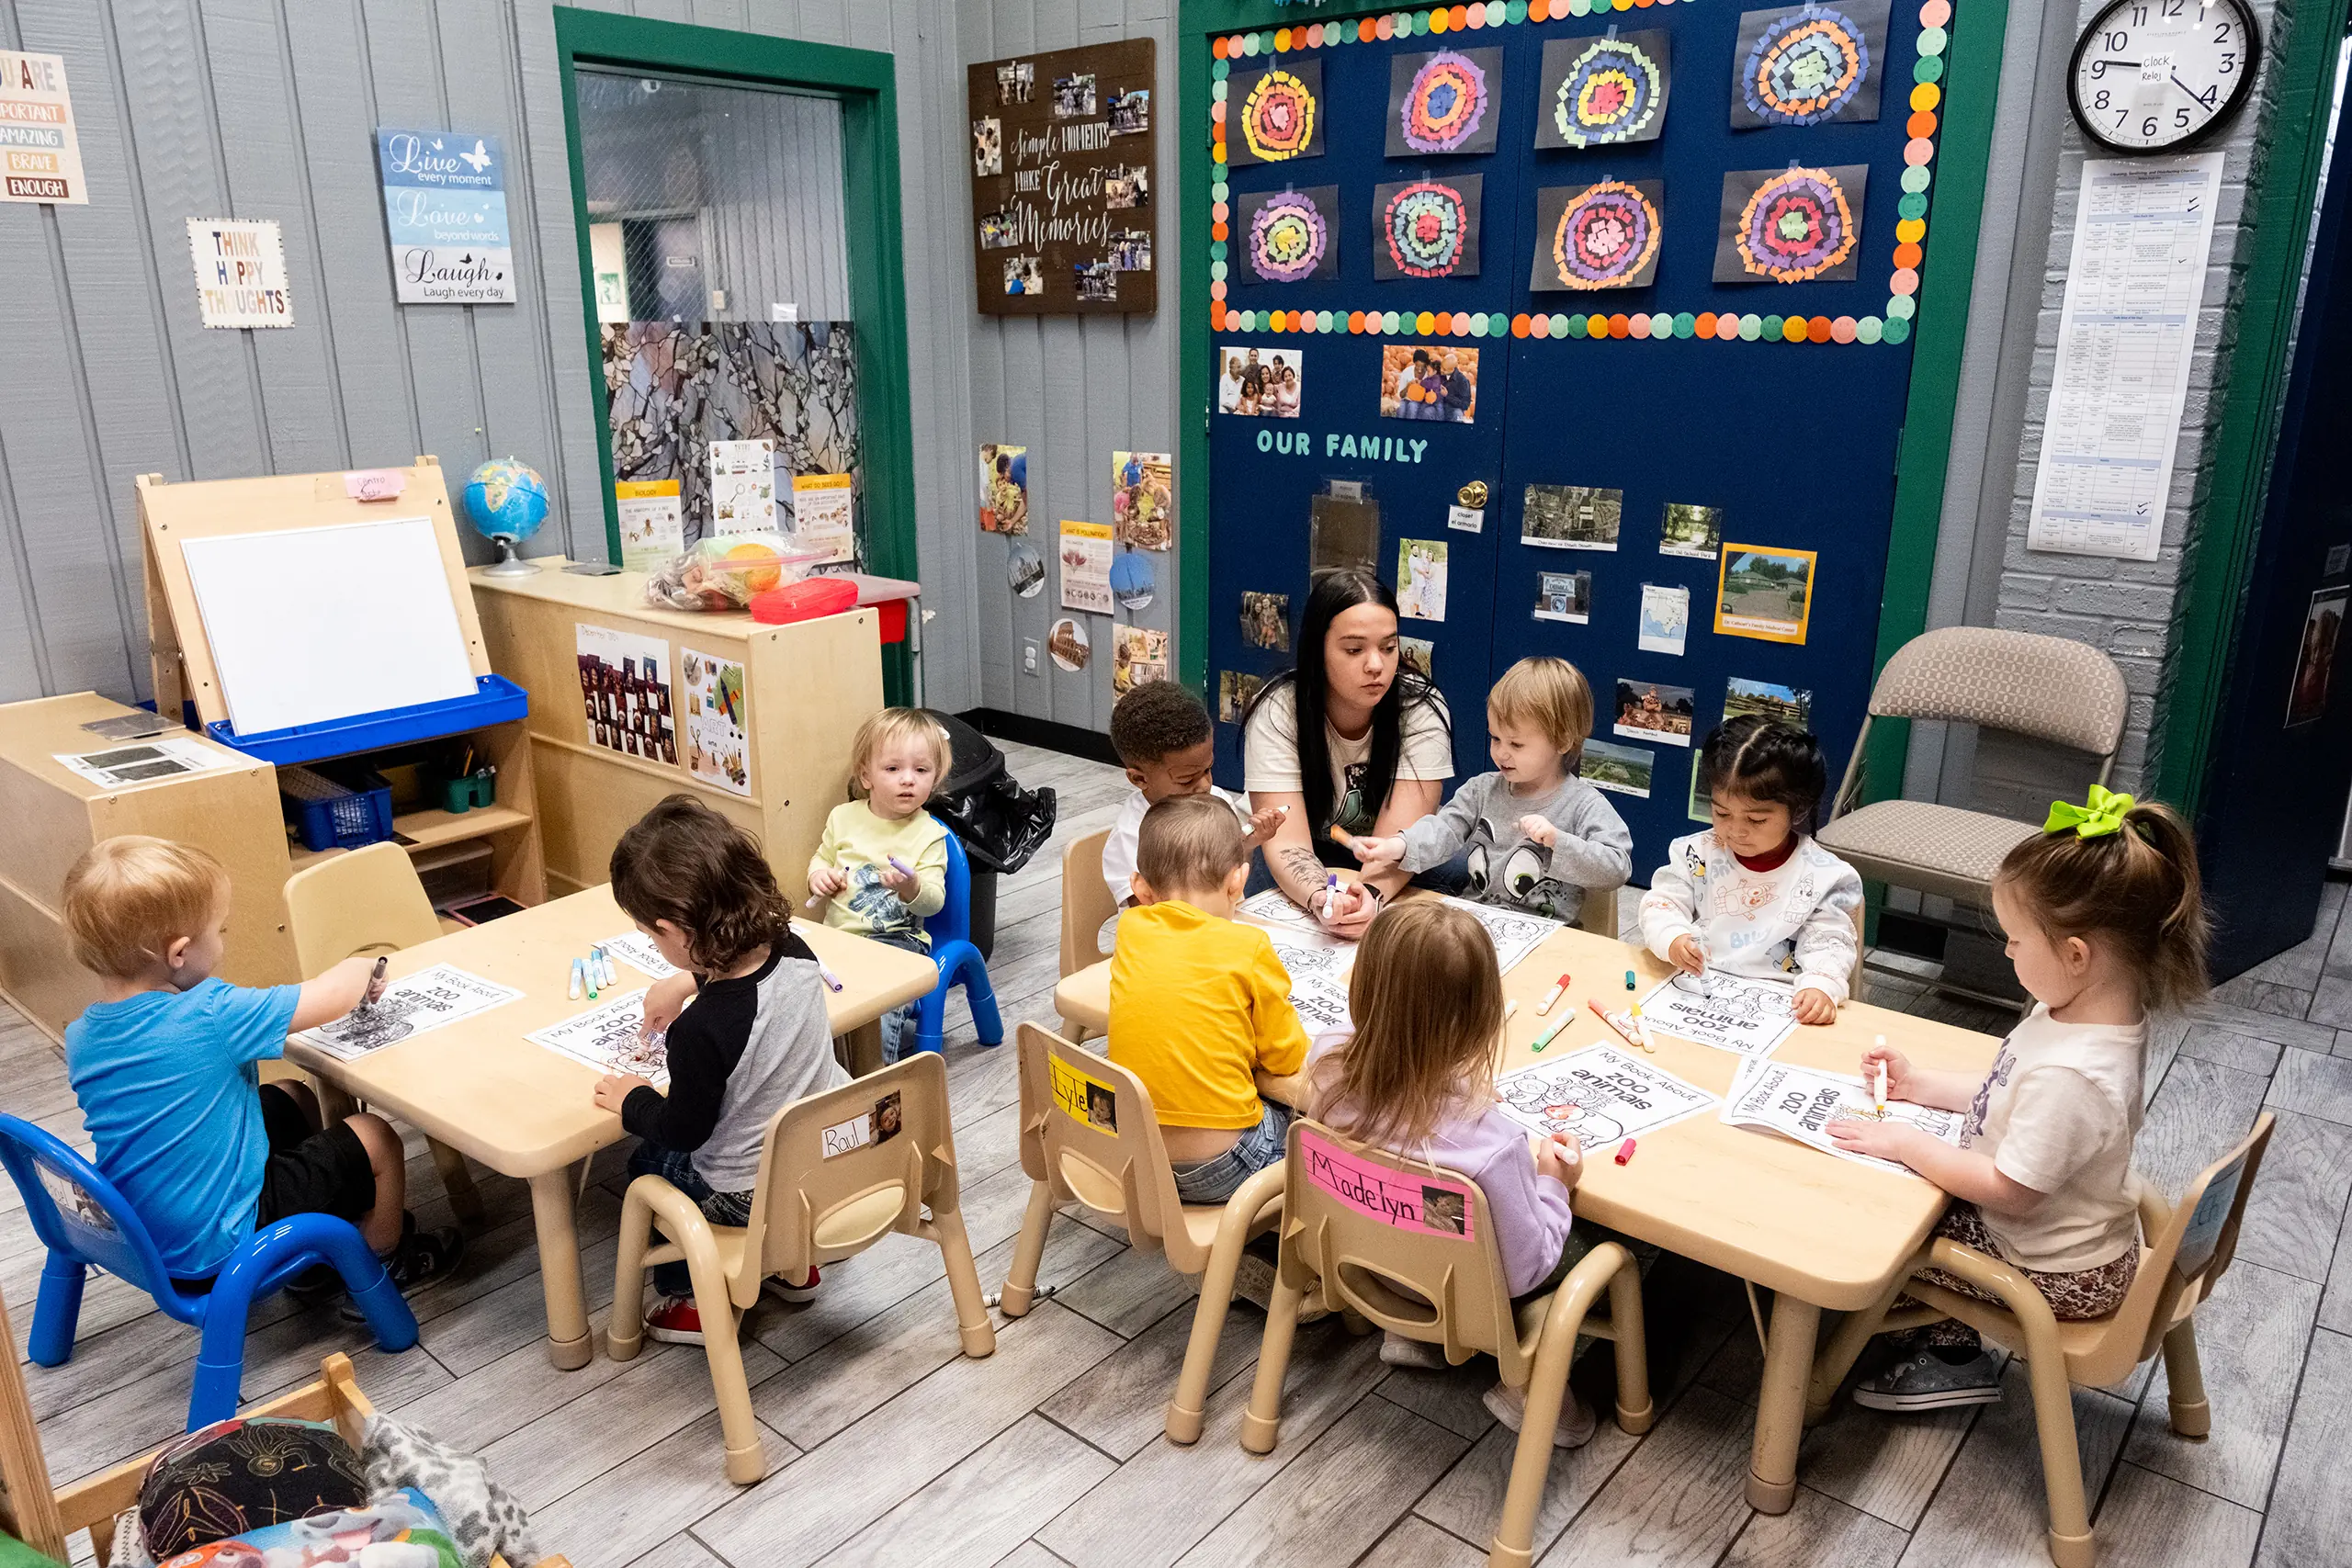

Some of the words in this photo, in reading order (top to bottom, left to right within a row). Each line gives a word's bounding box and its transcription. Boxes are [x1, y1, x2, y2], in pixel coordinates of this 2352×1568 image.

[2132, 6, 2148, 27] 11
[2161, 0, 2184, 17] 12
[2104, 31, 2128, 51] 10
[2213, 22, 2231, 43] 2
[2091, 60, 2107, 80] 9
[2143, 56, 2170, 68] Clock
[2218, 53, 2235, 73] 3
[21, 59, 57, 93] ARE
[2142, 72, 2162, 82] Reloj
[2095, 90, 2110, 109] 8
[2200, 85, 2217, 105] 4
[0, 102, 59, 122] PORTANT
[2115, 109, 2129, 129] 7
[2174, 107, 2190, 128] 5
[0, 127, 58, 147] AMAZING
[1061, 121, 1110, 152] MOMENTS
[2143, 117, 2158, 136] 6
[11, 152, 53, 171] BRAVE
[389, 133, 462, 174] Live
[10, 179, 64, 197] ENOUGH
[418, 173, 447, 185] every
[448, 173, 492, 185] moment
[1014, 169, 1041, 193] MAKE
[1041, 160, 1104, 217] Great
[397, 189, 472, 228] Love
[1010, 195, 1113, 254] Memories
[212, 231, 260, 256] THINK
[434, 230, 469, 243] beyond
[471, 231, 500, 242] words
[216, 260, 264, 286] HAPPY
[404, 248, 493, 288] Laugh
[204, 289, 285, 314] THOUGHTS
[424, 287, 456, 299] Laugh
[458, 288, 484, 299] every
[486, 287, 504, 299] day
[1256, 429, 1311, 456] OUR
[1326, 434, 1429, 464] FAMILY
[635, 489, 657, 497] BIOLOGY
[1457, 521, 1477, 529] armario
[701, 716, 727, 738] ART
[426, 986, 460, 1000] zoo
[433, 971, 443, 980] My
[445, 976, 469, 989] Book
[469, 987, 500, 999] About
[1307, 978, 1325, 988] My
[1324, 987, 1349, 1002] Book
[394, 987, 454, 1012] animals
[1308, 996, 1345, 1013] zoo
[550, 1028, 573, 1038] My
[573, 1012, 609, 1028] Book
[594, 1013, 637, 1032] zoo
[1643, 1015, 1684, 1032] About
[1668, 1001, 1759, 1031] animals
[1682, 1016, 1729, 1032] zoo
[592, 1018, 645, 1046] anim
[1691, 1027, 1727, 1043] Book
[1731, 1038, 1755, 1050] My
[1599, 1051, 1621, 1064] My
[1620, 1062, 1655, 1081] Book
[1655, 1080, 1699, 1101] About
[1605, 1072, 1650, 1093] zoo
[1763, 1069, 1788, 1091] About
[1052, 1064, 1088, 1114] Lyle
[1571, 1069, 1653, 1110] animals
[1749, 1089, 1774, 1108] Book
[1742, 1102, 1764, 1113] My
[1779, 1091, 1807, 1114] zoo
[1798, 1088, 1841, 1132] animals
[825, 1125, 859, 1156] Raul
[1311, 1149, 1416, 1225] Madelyn
